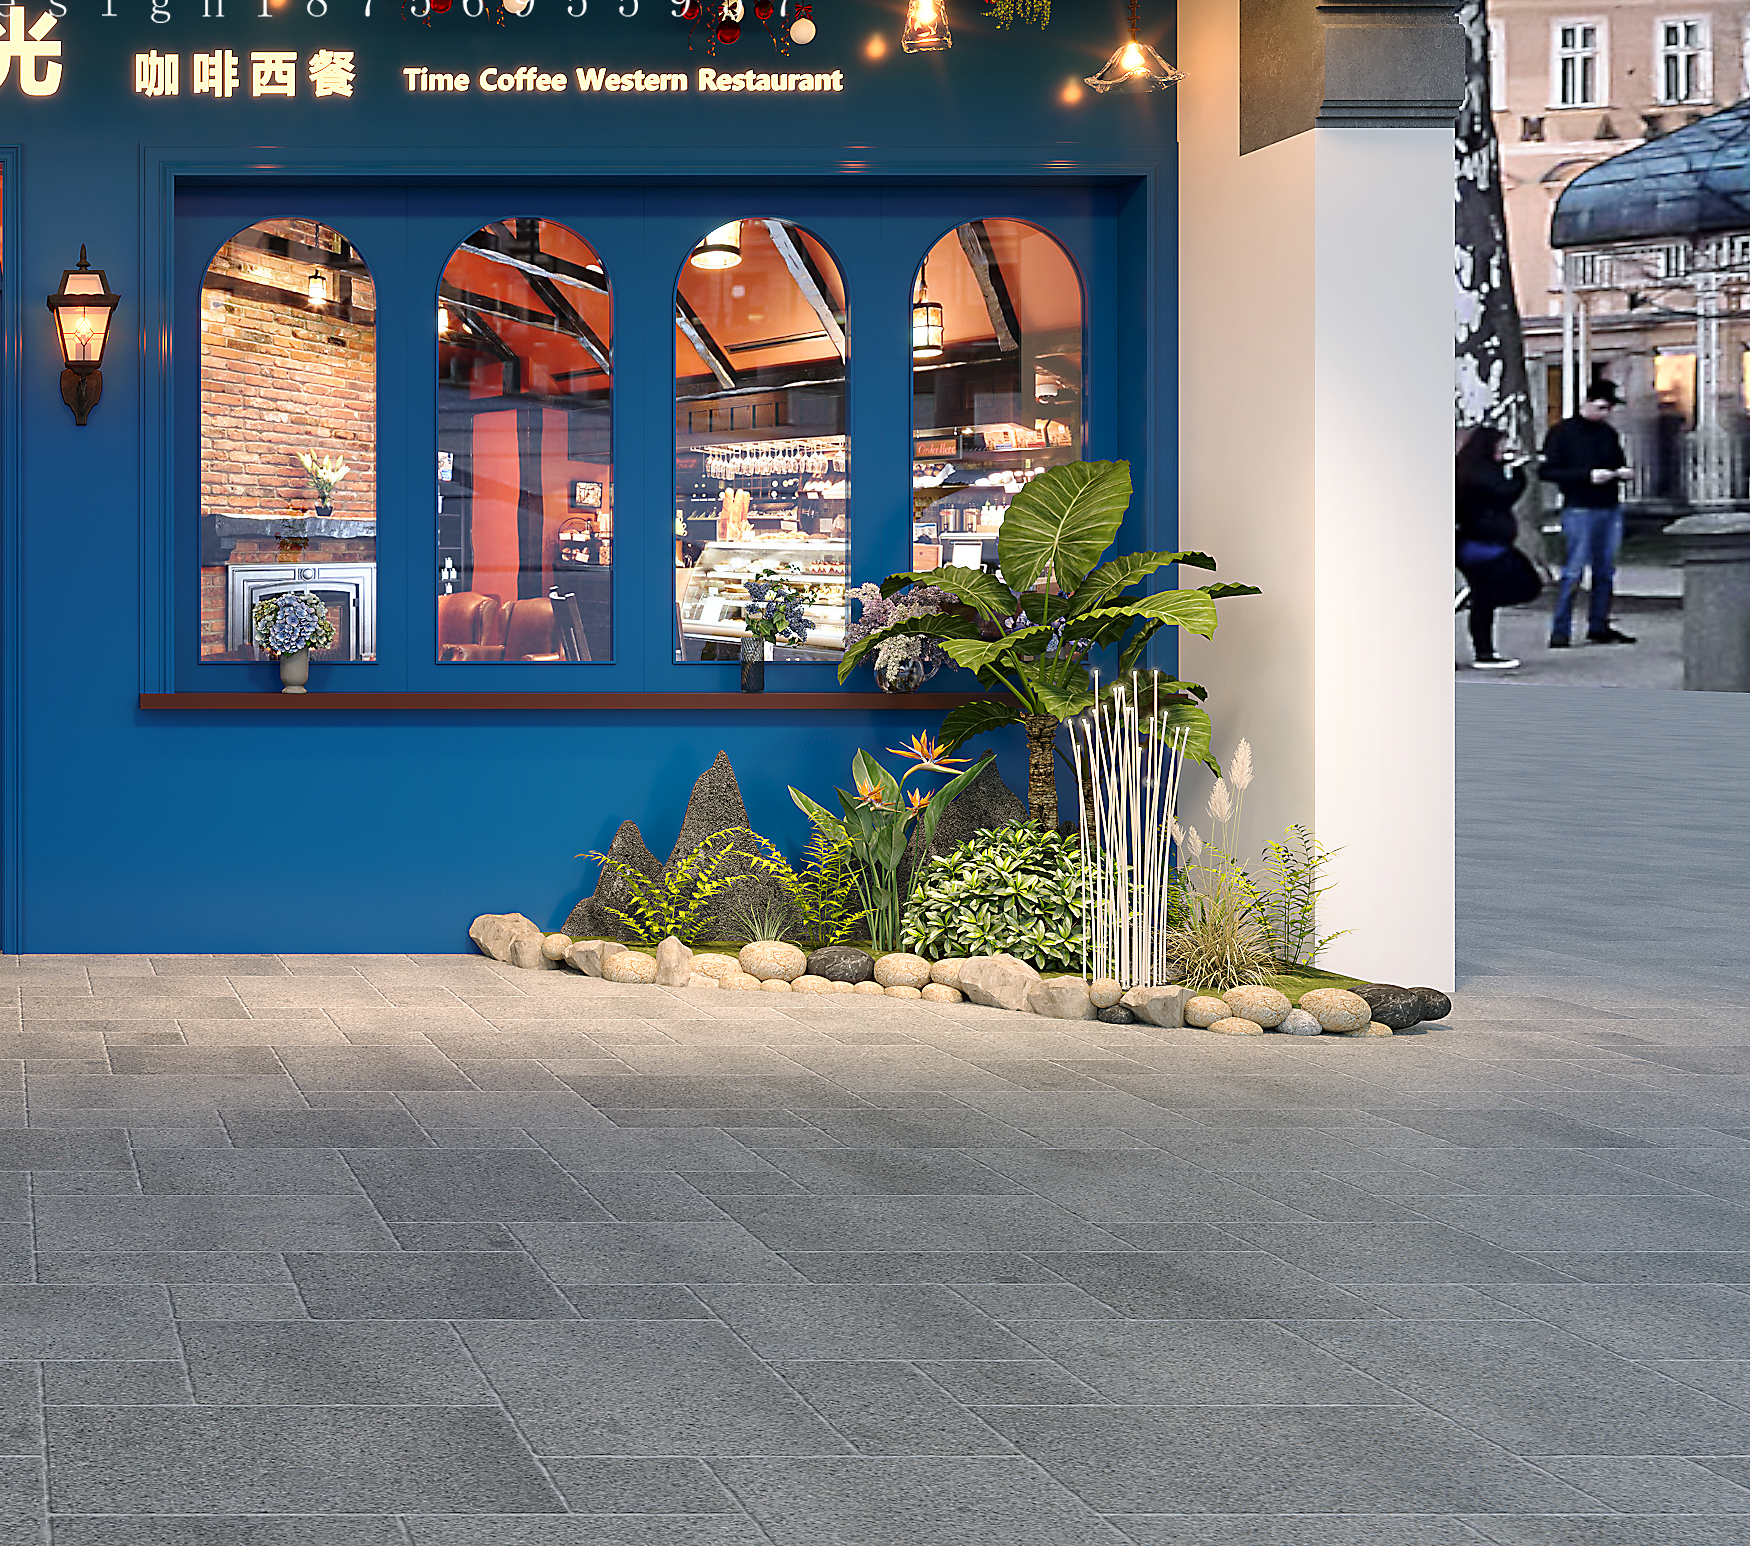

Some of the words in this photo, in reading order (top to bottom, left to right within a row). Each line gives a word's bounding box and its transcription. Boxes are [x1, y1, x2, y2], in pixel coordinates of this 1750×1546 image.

[135, 49, 356, 98] 咖啡西餐
[402, 66, 470, 92] Time
[479, 66, 568, 92] Coffee
[575, 68, 688, 92] Western
[698, 68, 844, 92] Restaurant
